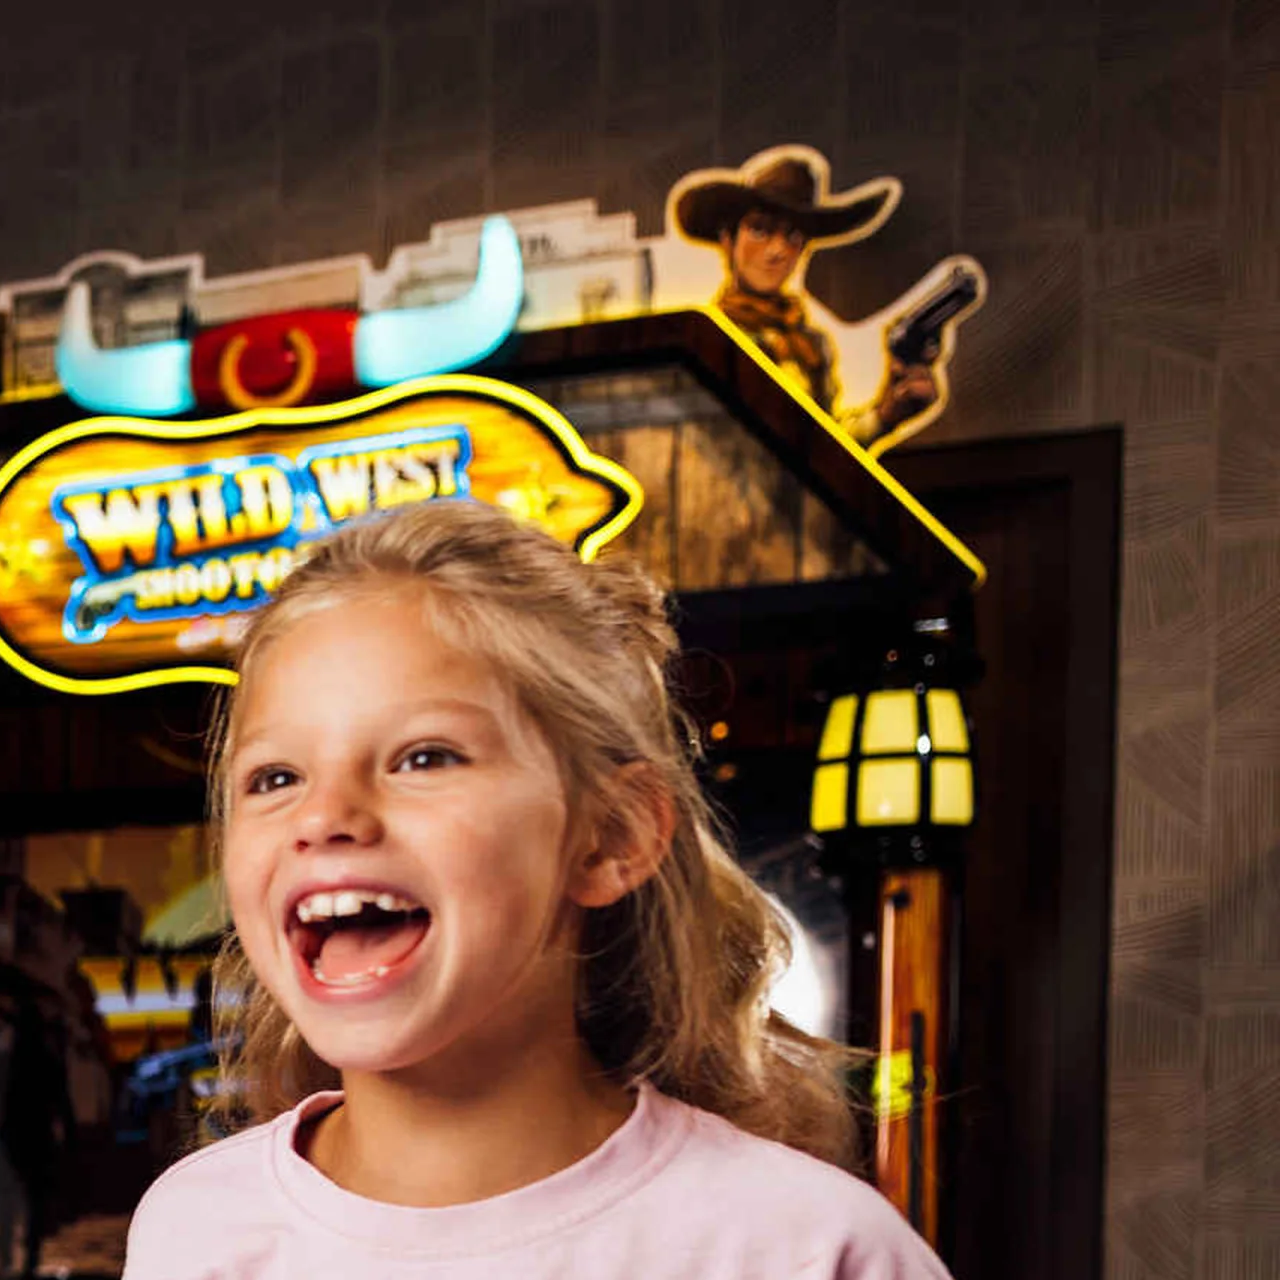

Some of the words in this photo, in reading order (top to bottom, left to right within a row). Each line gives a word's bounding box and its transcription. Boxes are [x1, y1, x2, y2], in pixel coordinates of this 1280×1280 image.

[63, 464, 292, 573] WILD
[309, 438, 461, 522] WEST
[135, 545, 312, 609] SHOOTO
